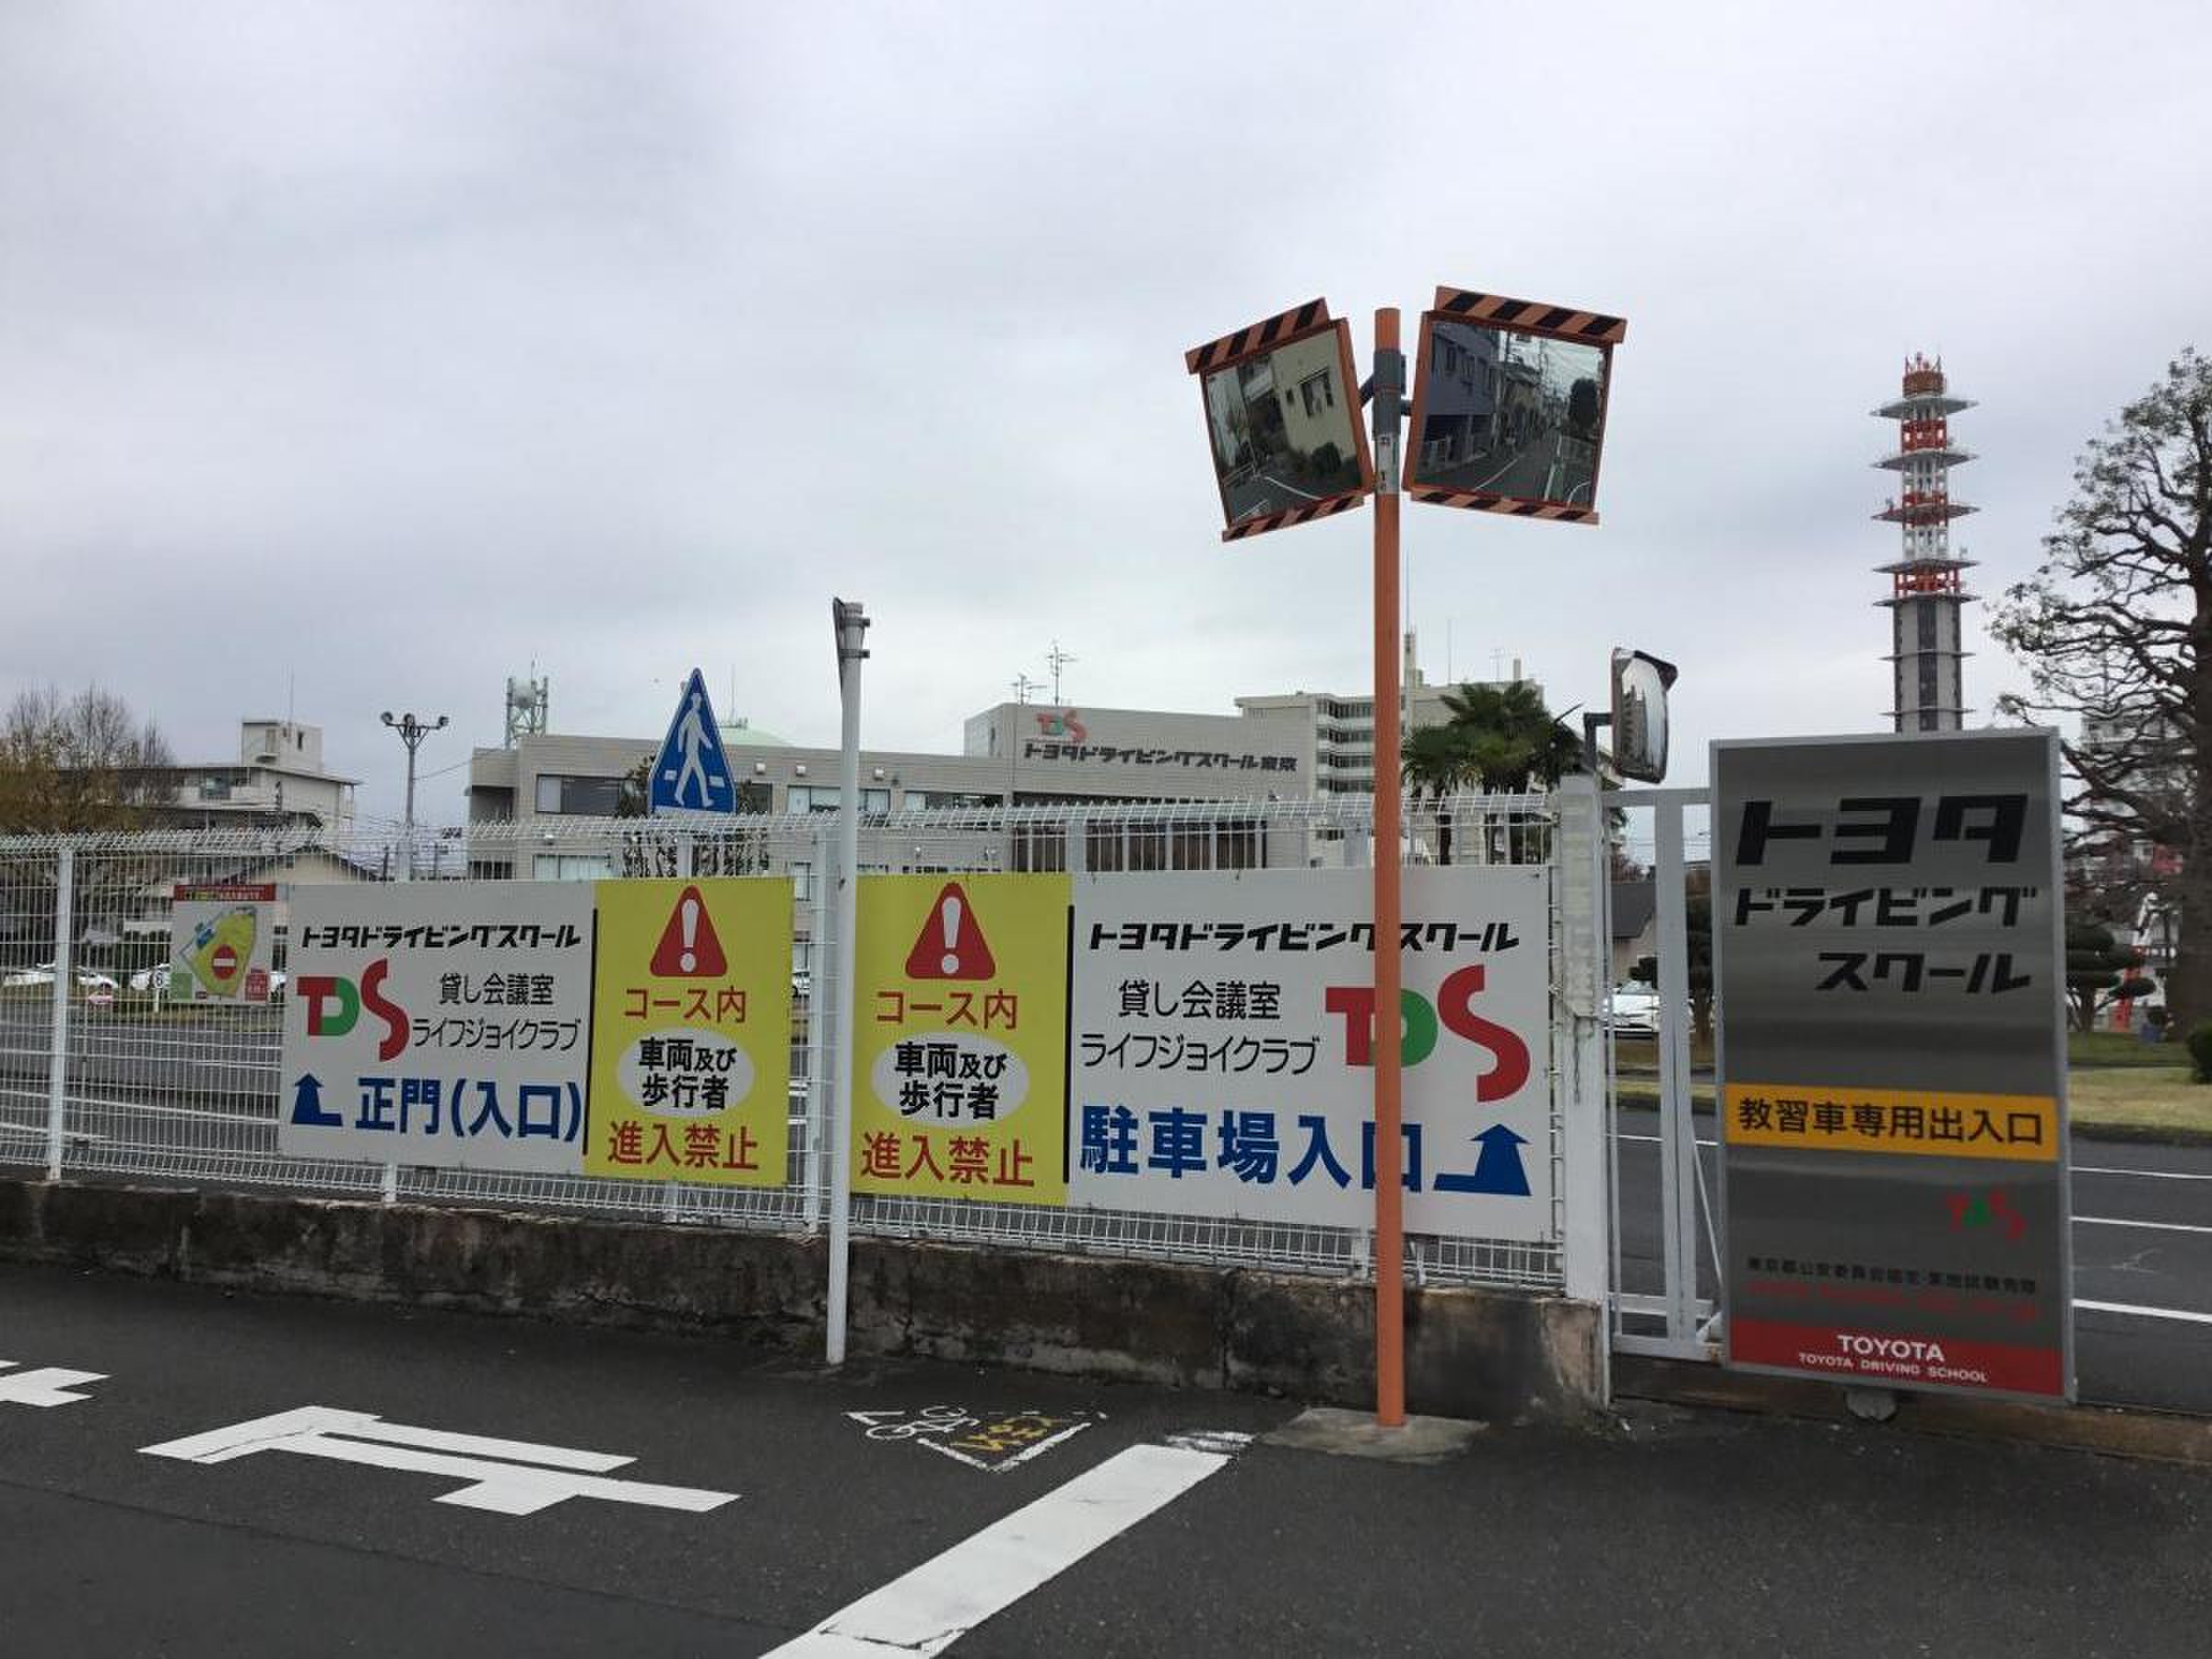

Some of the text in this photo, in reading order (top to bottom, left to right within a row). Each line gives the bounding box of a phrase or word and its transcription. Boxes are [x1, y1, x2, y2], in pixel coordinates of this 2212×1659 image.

[1735, 794, 2028, 865] トヨタ
[1735, 887, 2039, 926] ドライビング
[302, 924, 581, 948] トヨタドライビングスクール
[440, 972, 554, 1006] 貸し会議室
[1816, 952, 2030, 994] スクール
[296, 958, 410, 1062] TDS
[624, 985, 747, 1023] コース内
[877, 988, 1018, 1030] コース内
[1118, 979, 1280, 1020] 貸し会議室
[412, 1017, 582, 1051] ライフジョイクラブ
[1080, 1032, 1321, 1076] ライフジョイクラブ
[639, 1037, 737, 1072] 車両及び
[895, 1041, 1007, 1079] 車両及び
[355, 1077, 582, 1142] 正門(入口)
[642, 1073, 729, 1110] 歩行者
[900, 1080, 999, 1120] 歩行者
[1738, 1097, 2043, 1146] 教習車専用出入口
[607, 1120, 759, 1171] 進入禁止
[860, 1131, 1035, 1187] 進入禁止
[1079, 1104, 1422, 1194] 駐車場入口
[1798, 1352, 1989, 1382] TOYOTA DRIVING SCHOOL
[1838, 1334, 1945, 1361] TOYOTA
